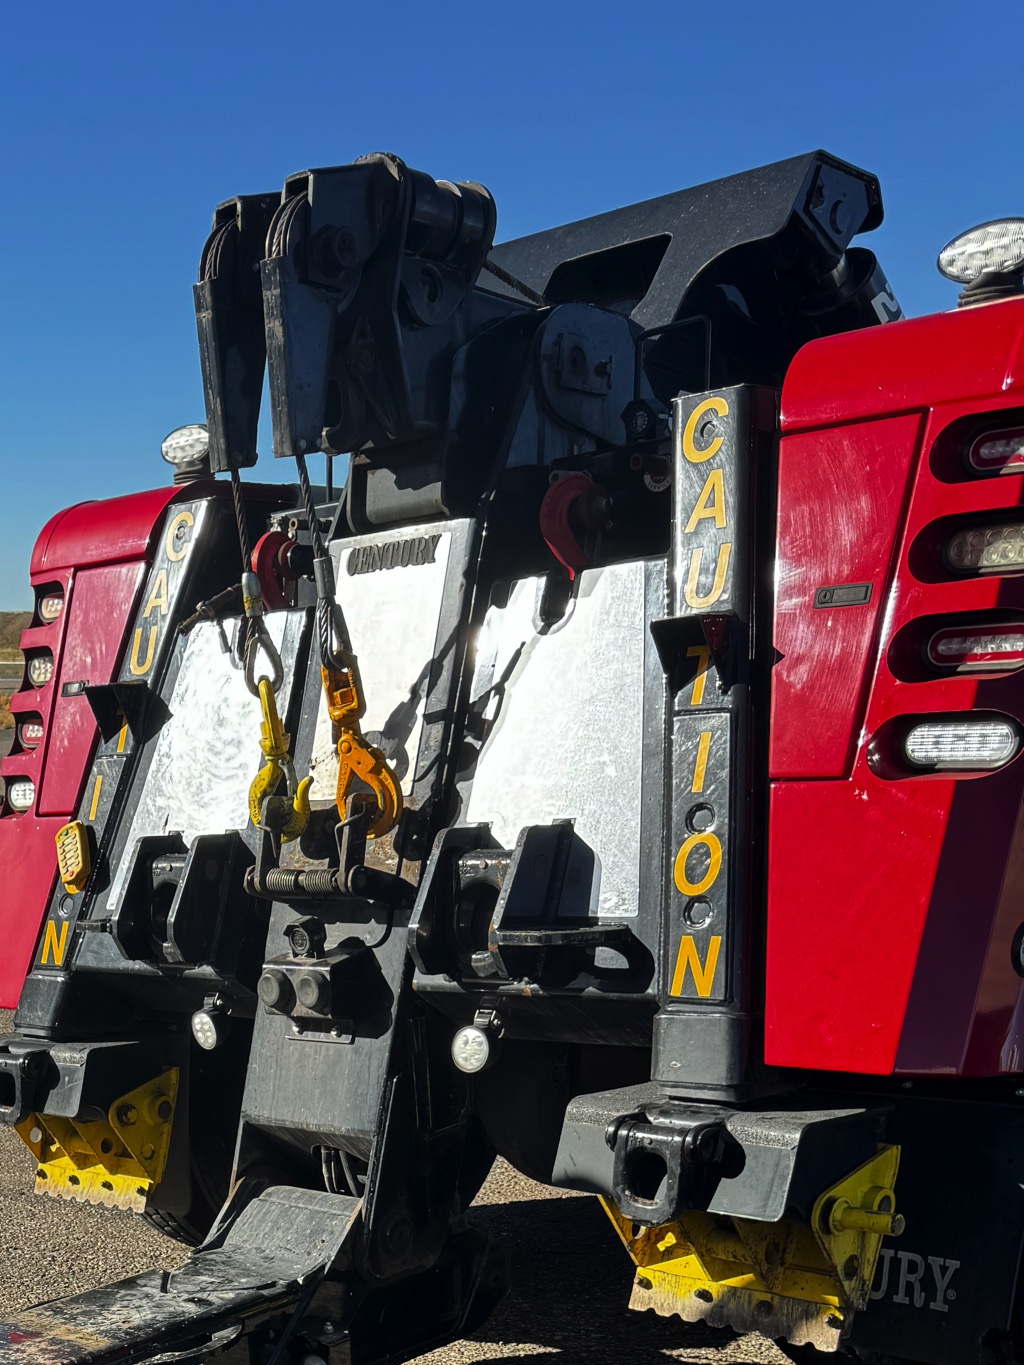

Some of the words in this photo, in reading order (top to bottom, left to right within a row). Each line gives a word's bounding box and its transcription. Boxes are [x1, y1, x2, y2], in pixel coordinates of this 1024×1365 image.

[40, 511, 194, 966] CAUTIN
[346, 533, 442, 577] CENTURY
[670, 396, 729, 998] CAUTION
